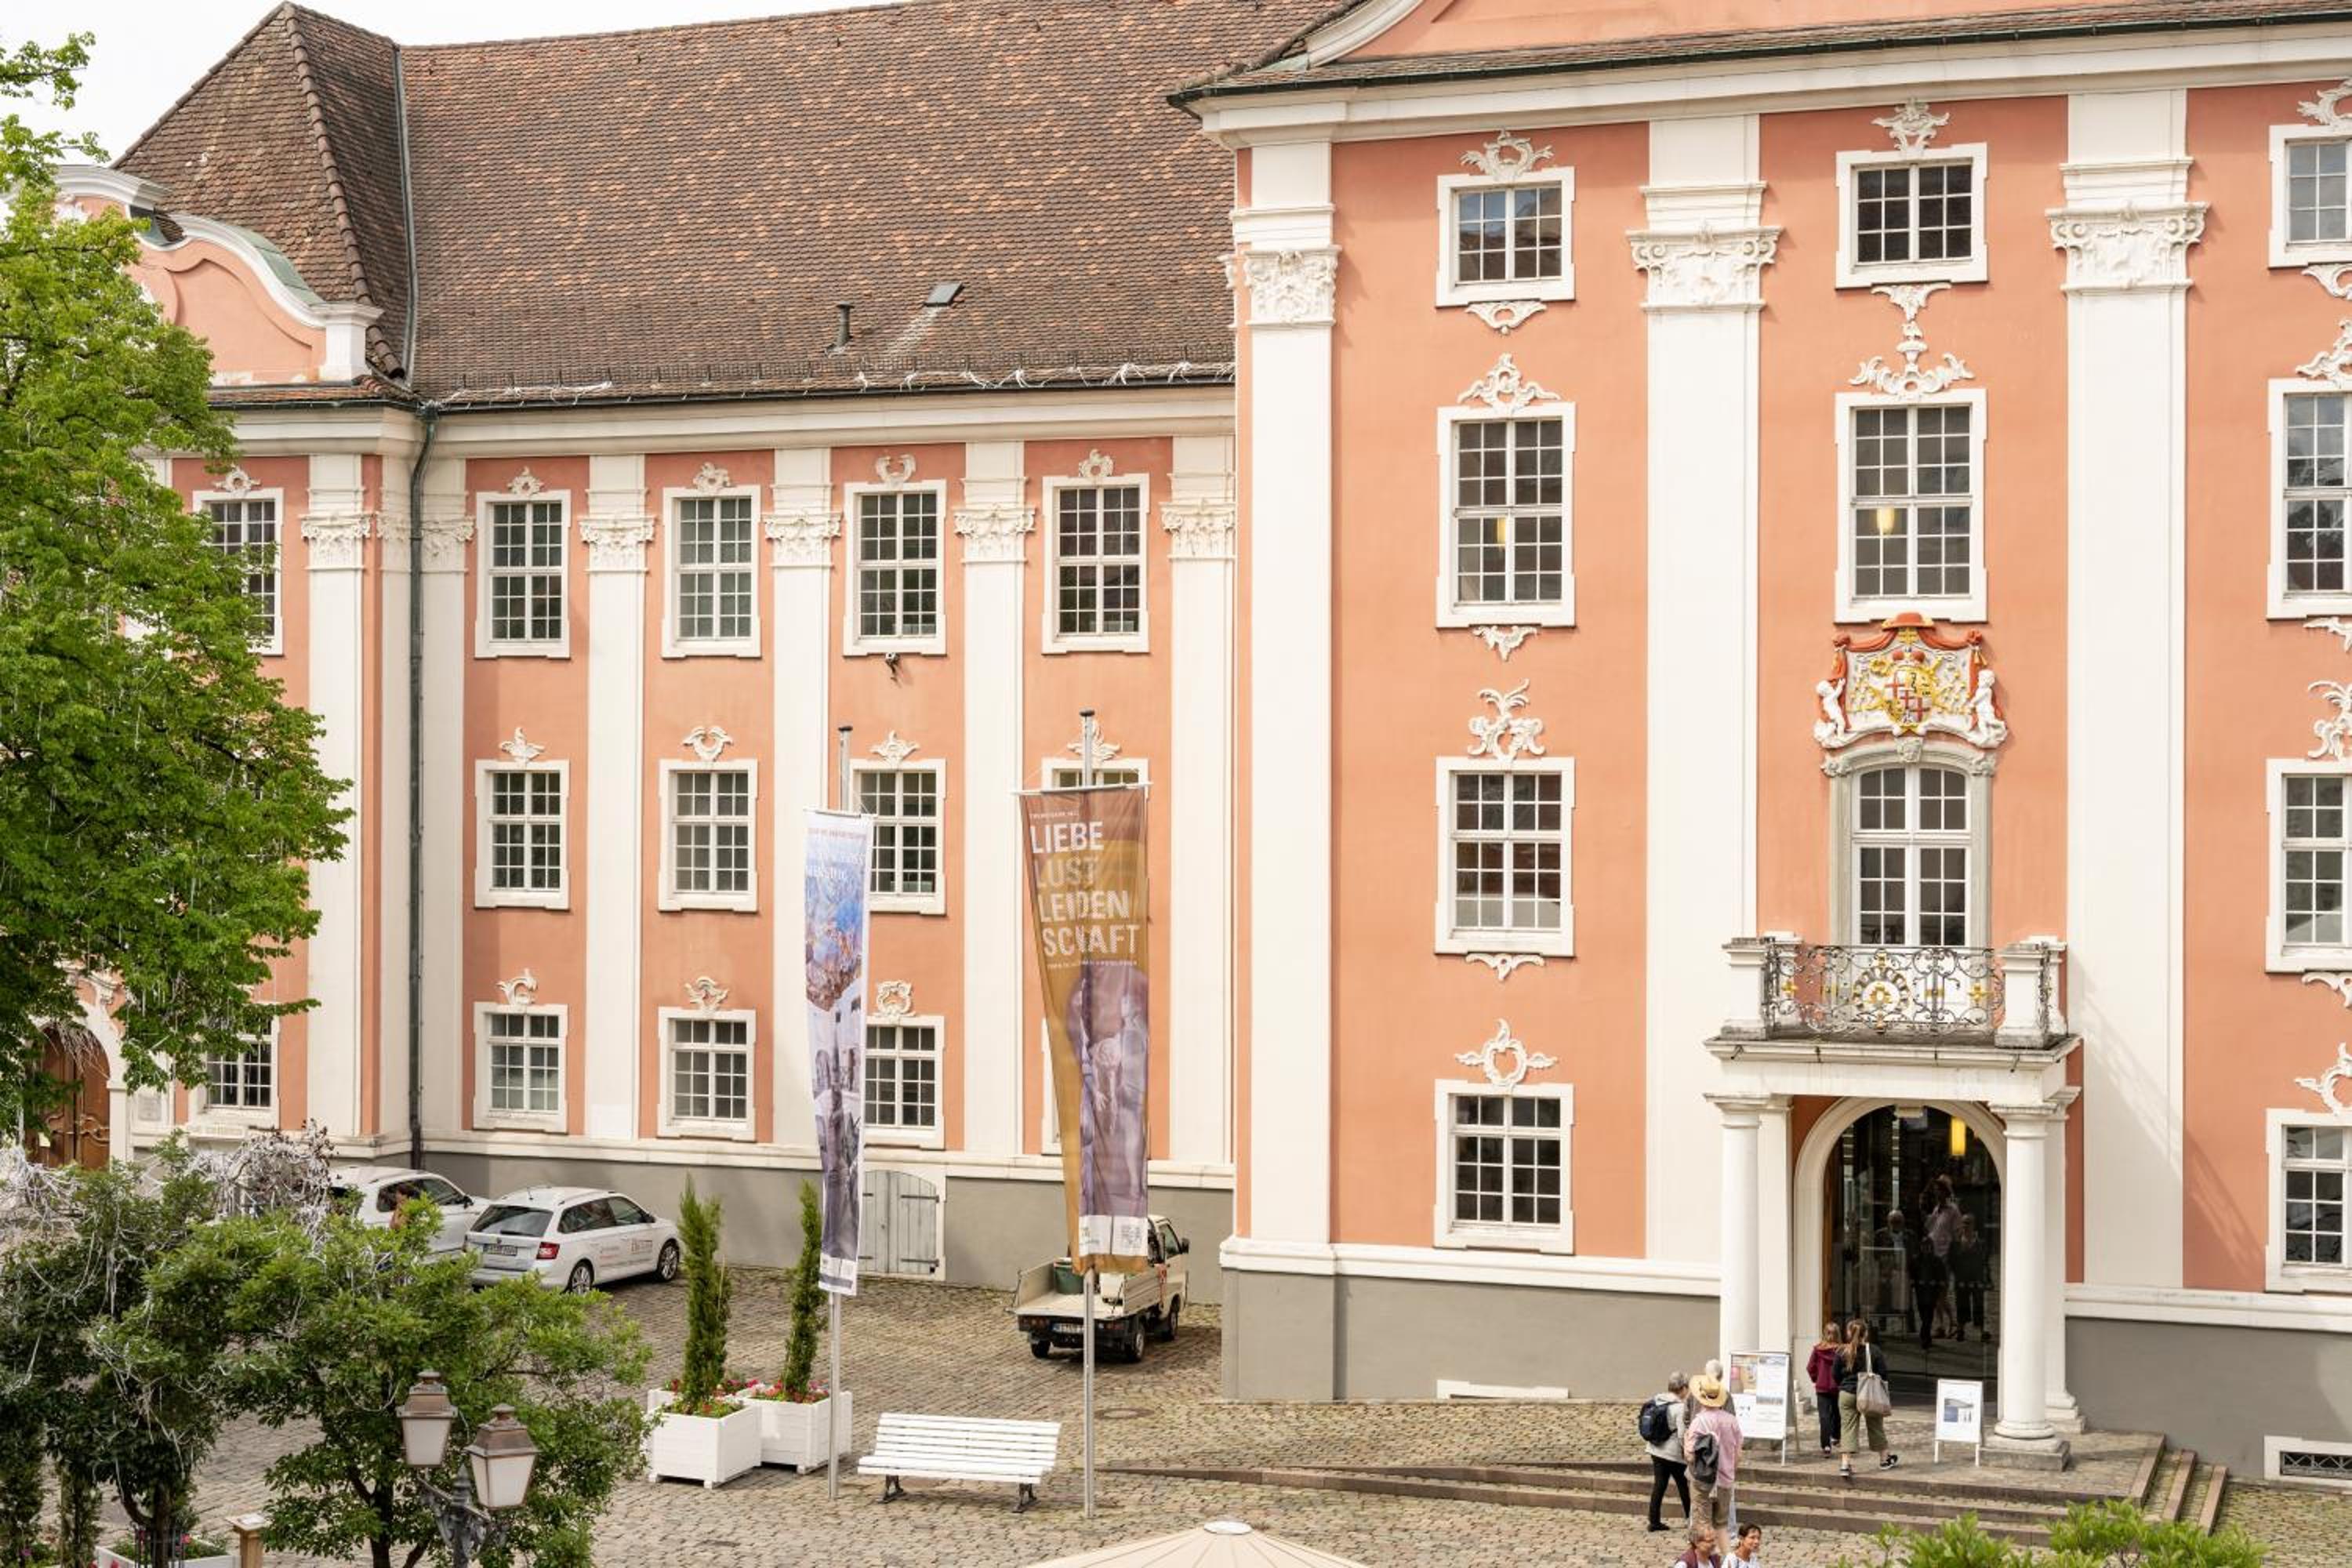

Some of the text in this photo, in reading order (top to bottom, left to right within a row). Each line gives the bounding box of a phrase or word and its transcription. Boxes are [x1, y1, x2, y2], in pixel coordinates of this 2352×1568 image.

[1030, 821, 1104, 854] LIEBE
[1033, 855, 1098, 888] LUST
[1037, 890, 1130, 923] LEIDEN
